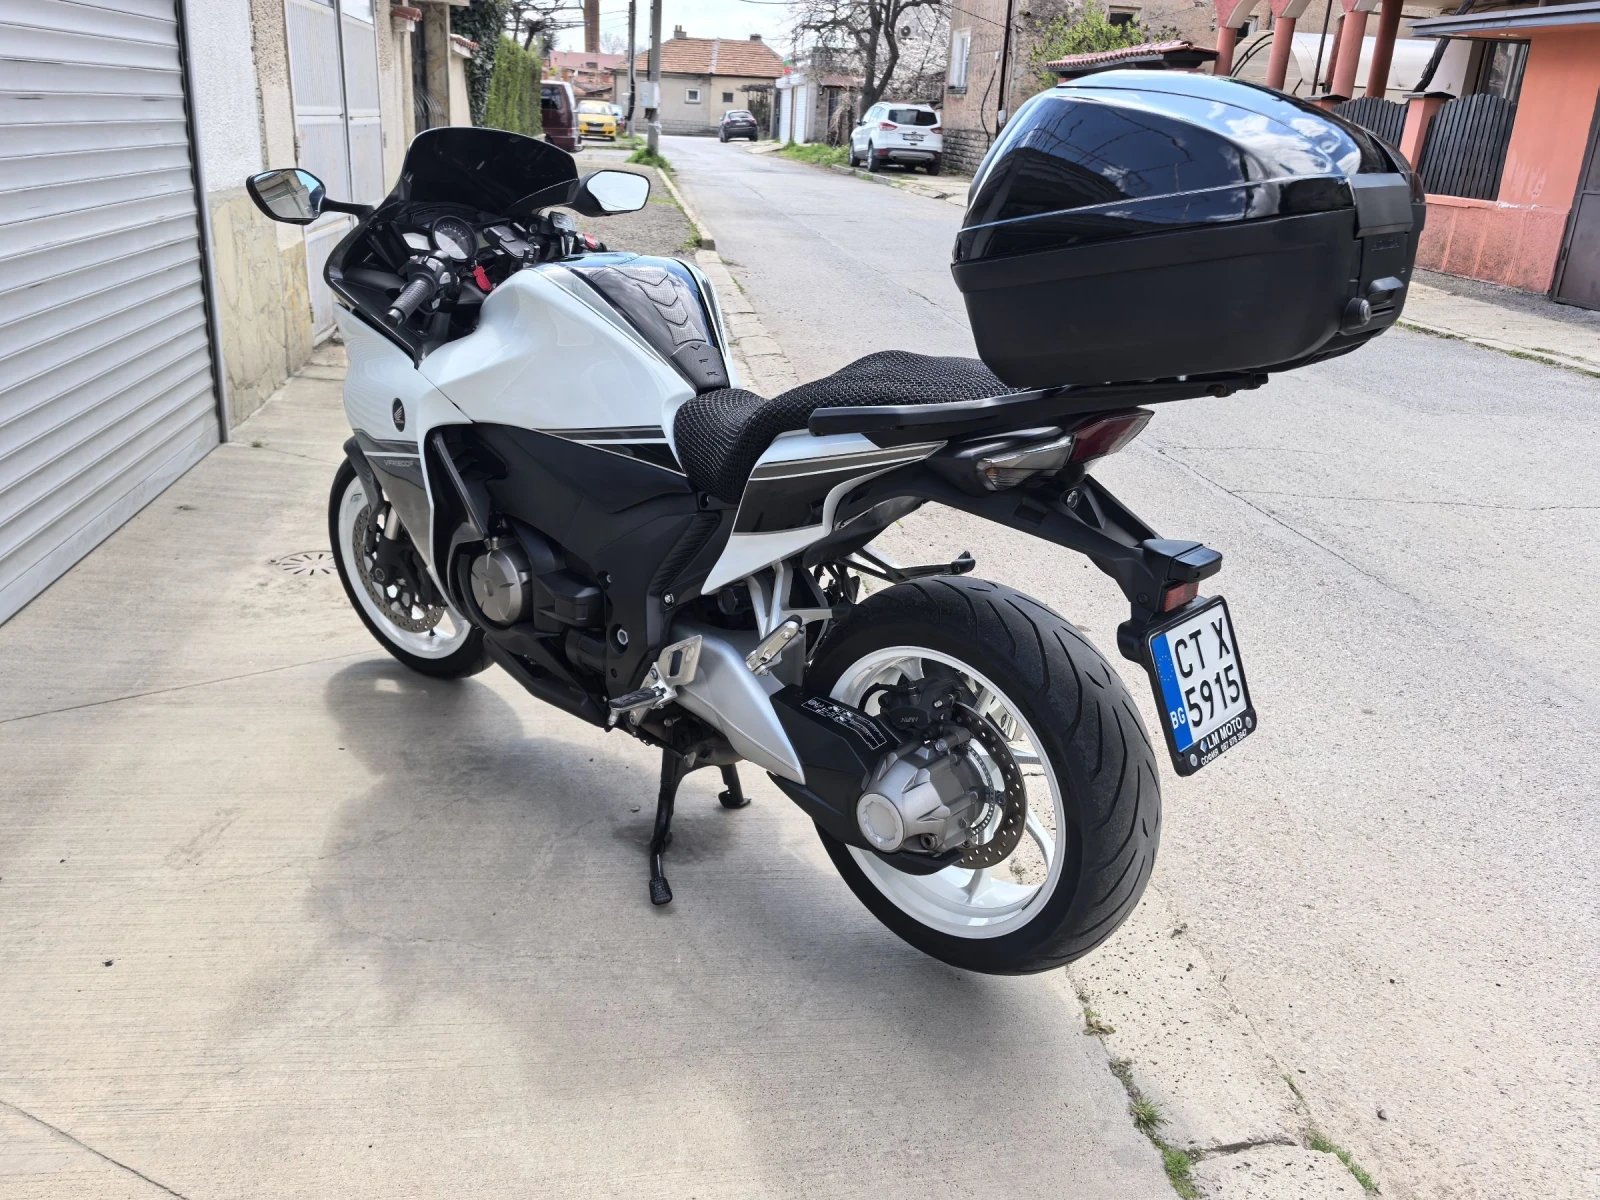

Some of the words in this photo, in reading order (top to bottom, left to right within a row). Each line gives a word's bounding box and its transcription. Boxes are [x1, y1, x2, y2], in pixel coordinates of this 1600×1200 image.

[1174, 628, 1206, 679] CT
[1211, 617, 1231, 659] X
[1170, 707, 1187, 730] BG
[1184, 664, 1240, 728] 5915
[1206, 731, 1220, 749] LM
[1219, 717, 1242, 741] MOTO
